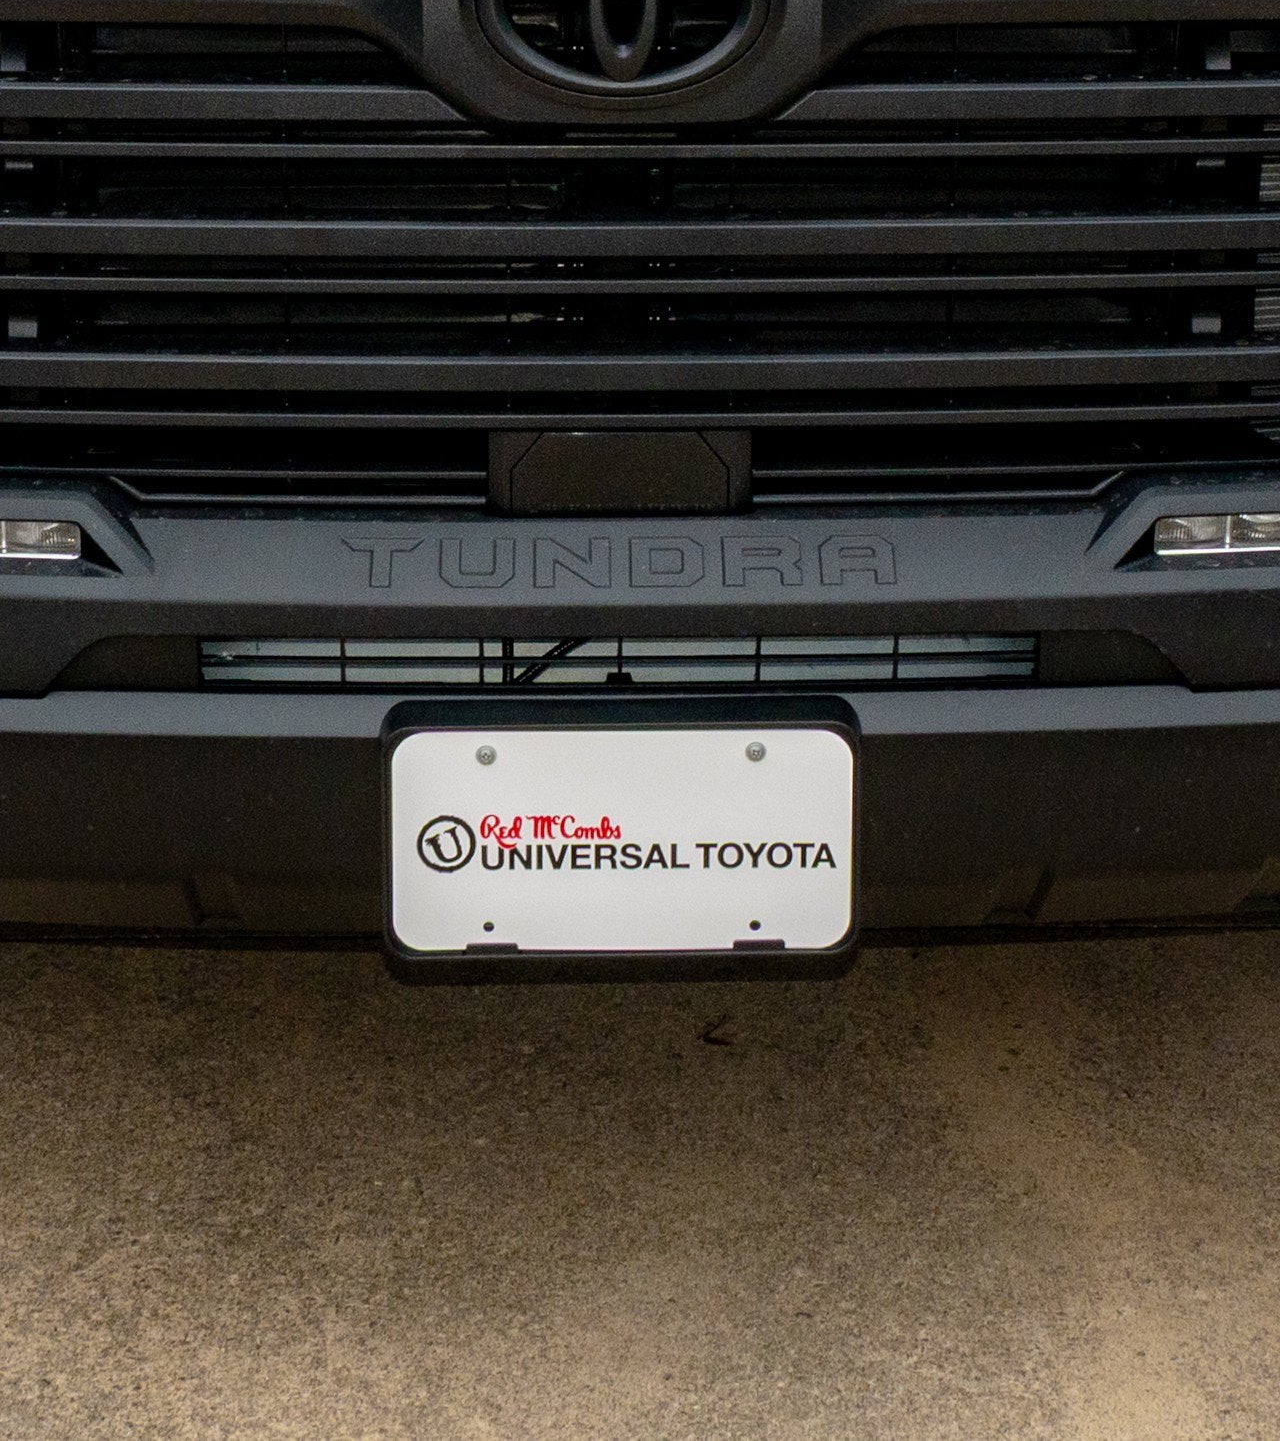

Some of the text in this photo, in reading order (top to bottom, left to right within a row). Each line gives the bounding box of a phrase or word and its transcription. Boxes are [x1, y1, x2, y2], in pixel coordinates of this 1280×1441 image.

[340, 535, 897, 589] TUNDRA
[479, 814, 622, 849] Red McCombs
[481, 842, 837, 870] UNIVERSAL TOYOTA
